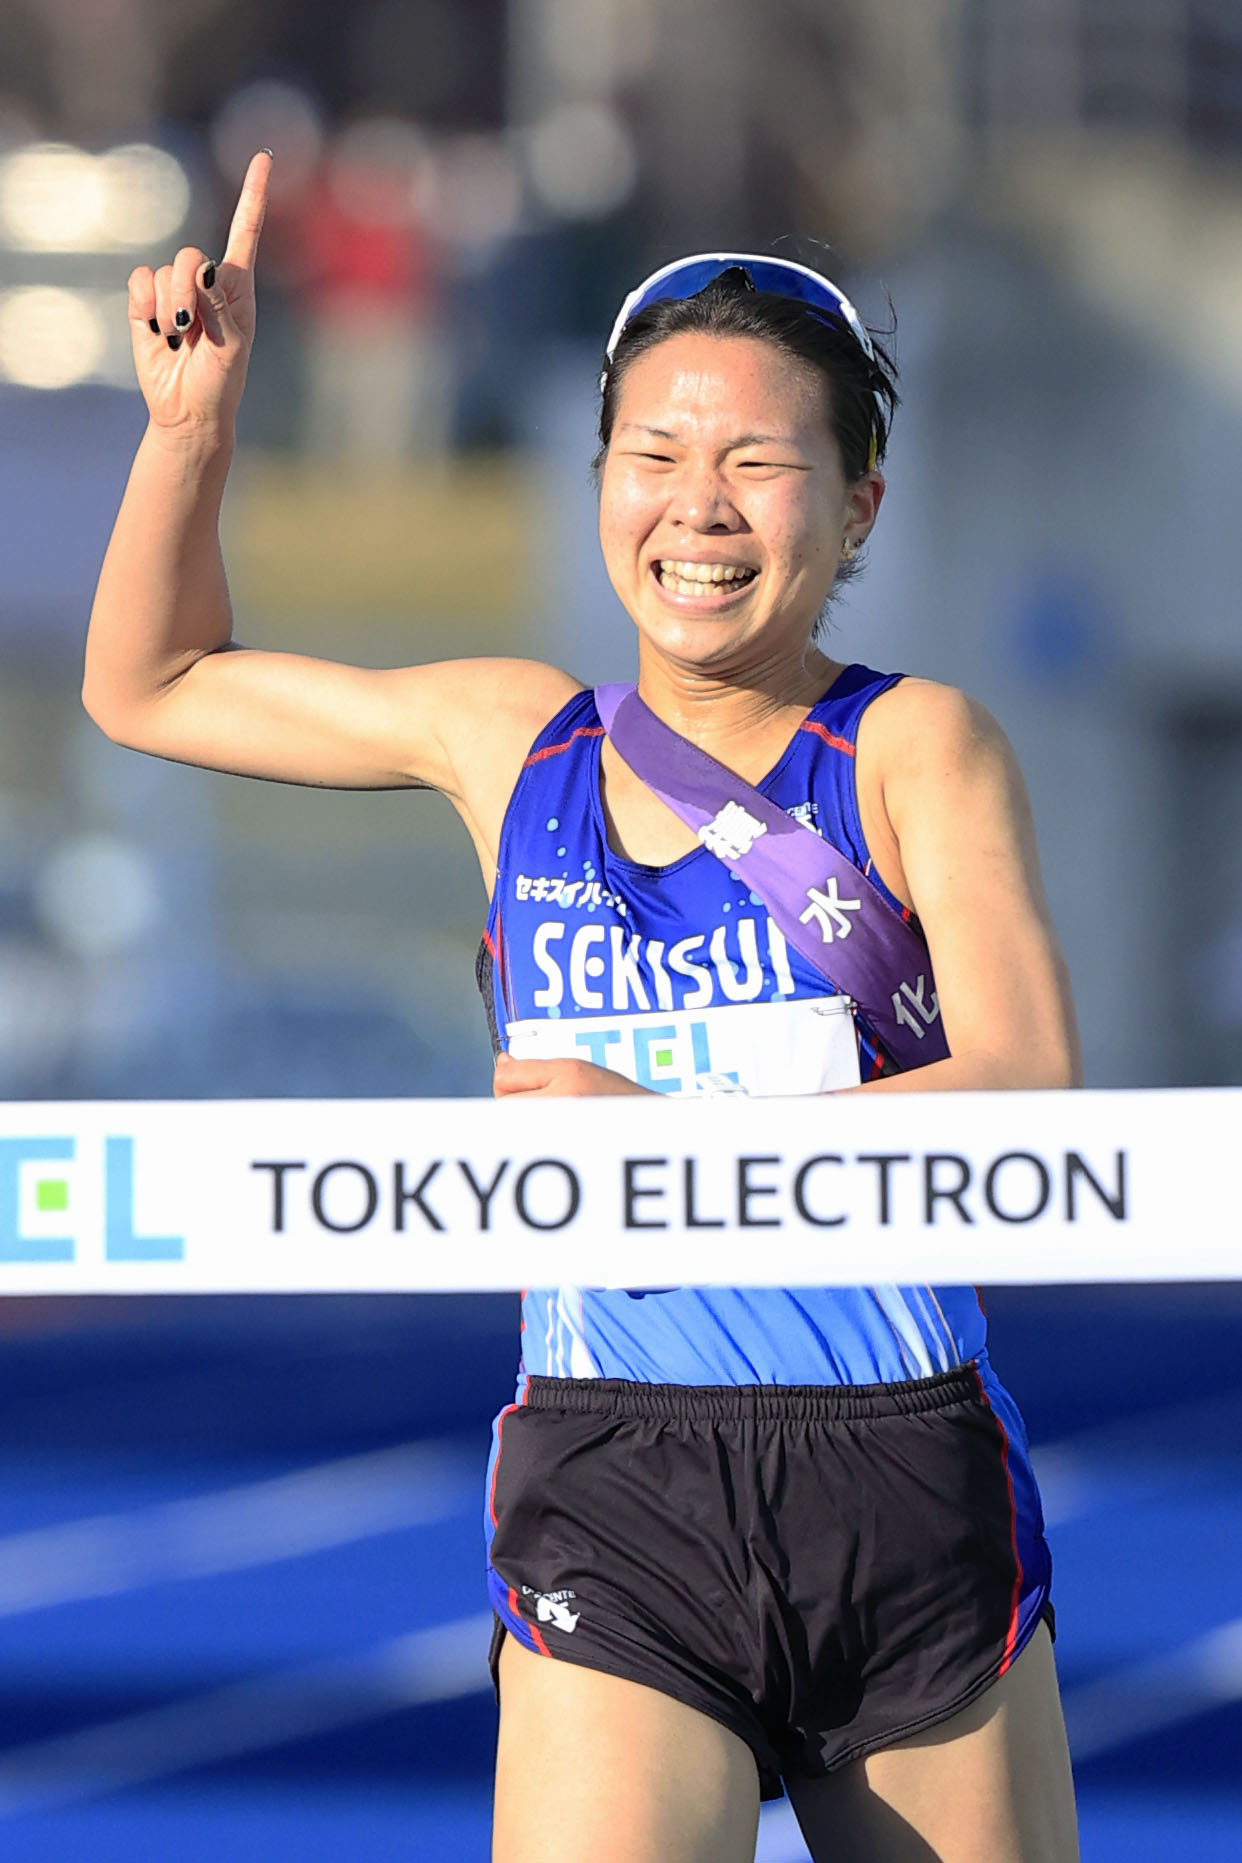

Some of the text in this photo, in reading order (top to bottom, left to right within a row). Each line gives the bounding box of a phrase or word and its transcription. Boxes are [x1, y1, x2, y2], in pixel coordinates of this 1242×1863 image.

[533, 917, 795, 1010] SEKISUI
[575, 1021, 739, 1095] TEL
[250, 1158, 582, 1233] TOKYO
[622, 1148, 1128, 1230] ELECTRON
